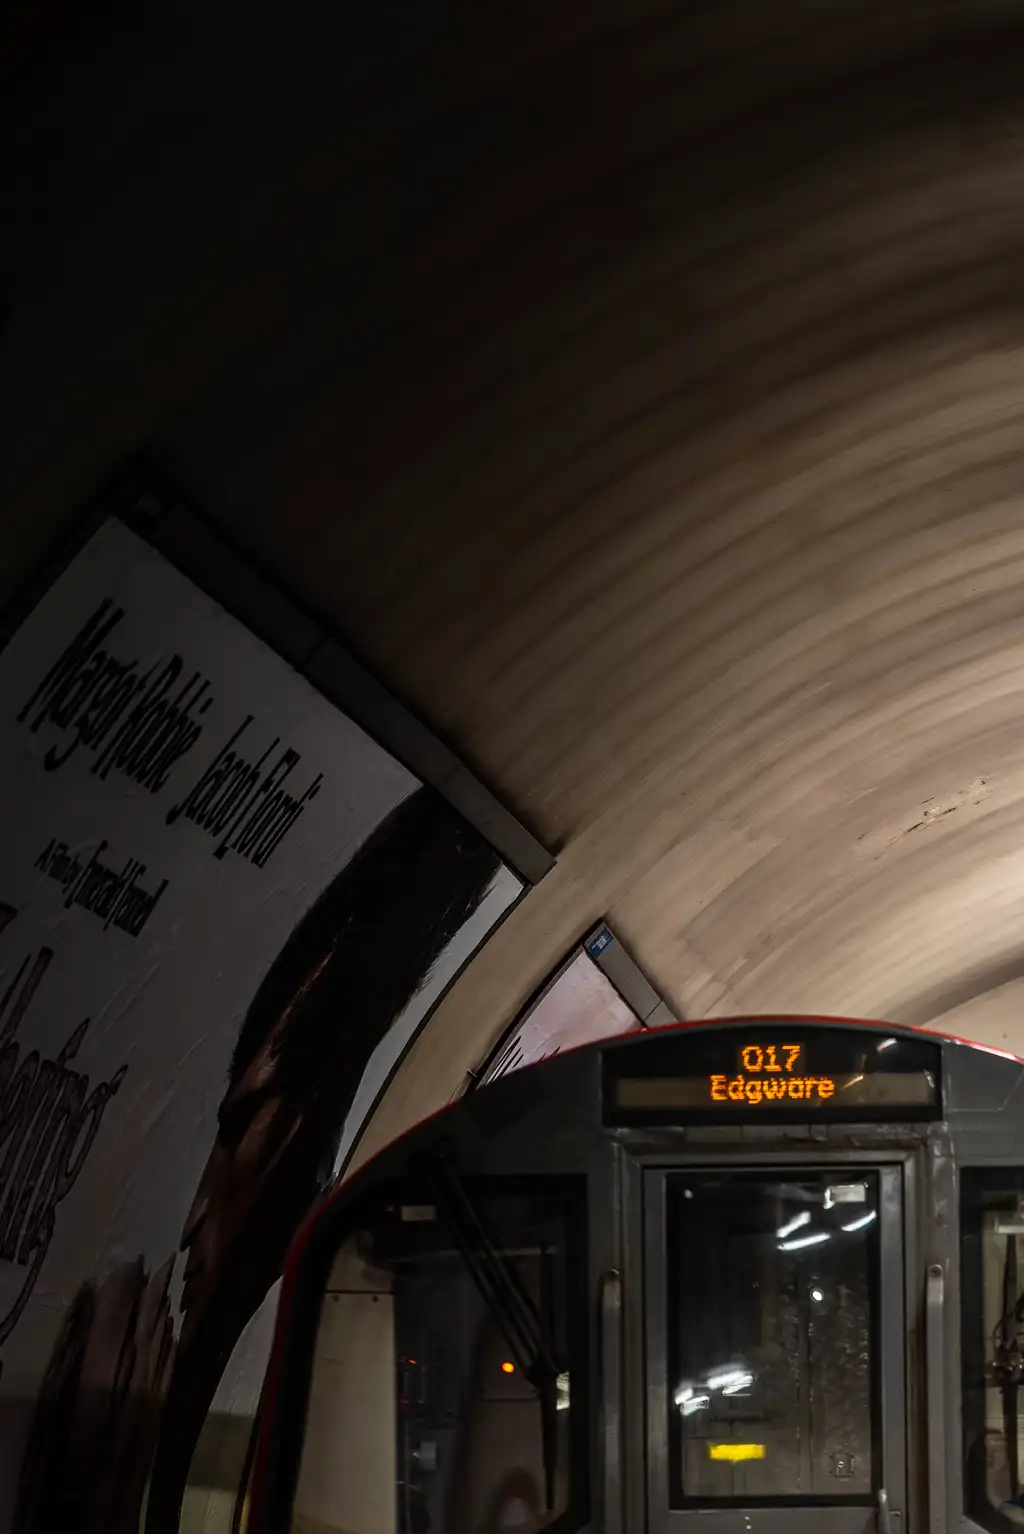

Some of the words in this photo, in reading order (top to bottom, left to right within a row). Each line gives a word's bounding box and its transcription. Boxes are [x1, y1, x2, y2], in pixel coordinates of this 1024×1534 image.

[16, 597, 163, 771] Margot
[91, 654, 214, 793] Robbie
[165, 715, 280, 837] Jacob
[213, 747, 323, 868] Elordi
[710, 1075, 835, 1104] Edgware
[742, 1045, 800, 1072] 017
